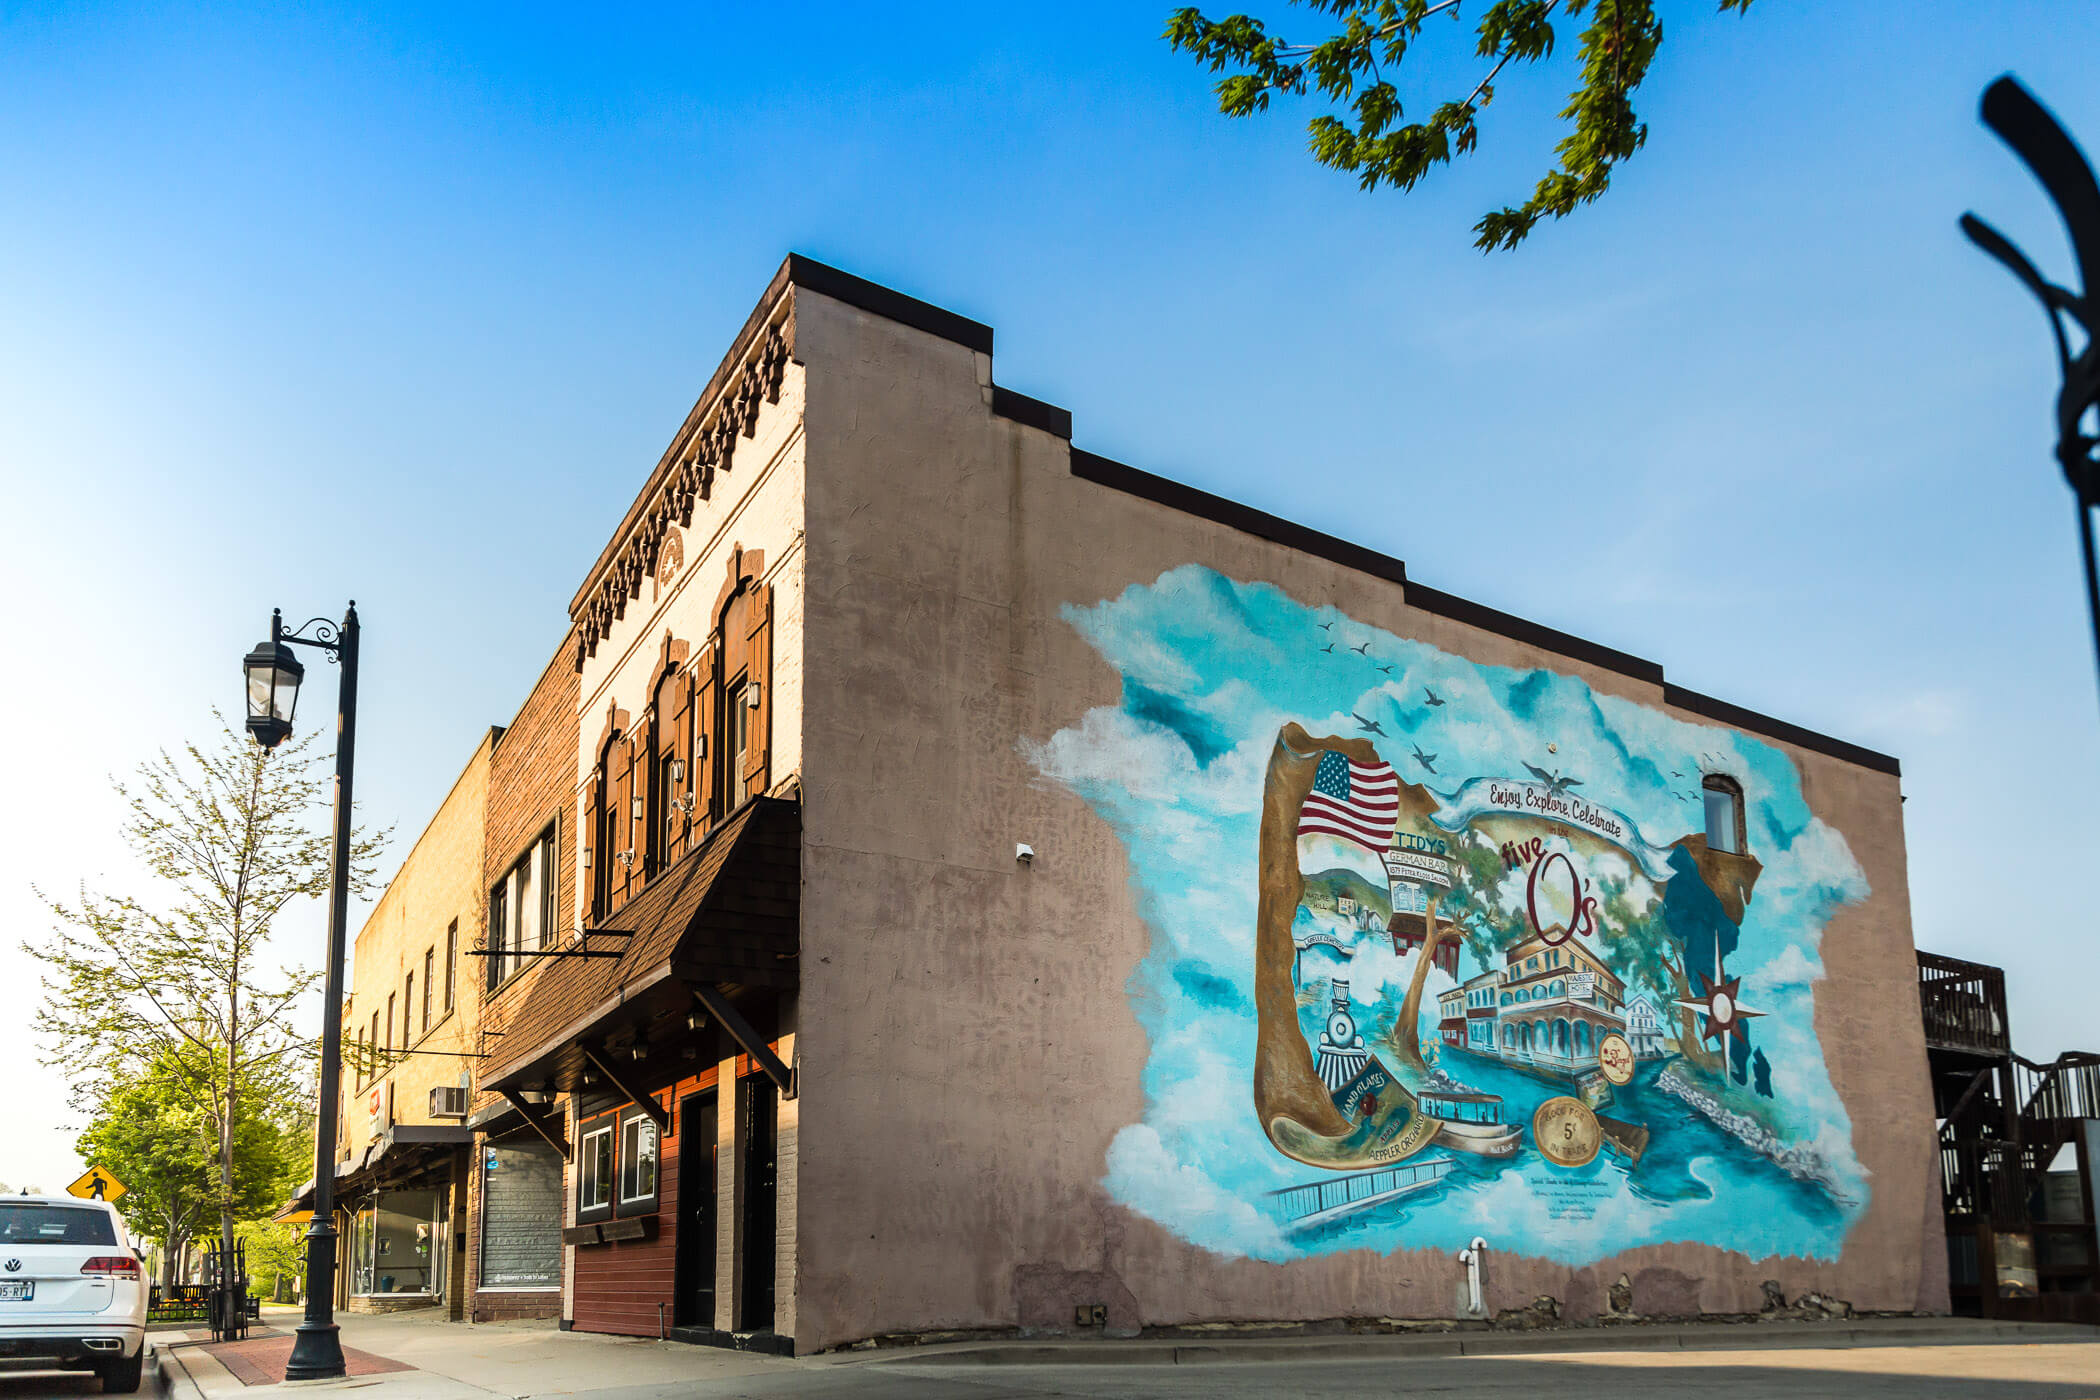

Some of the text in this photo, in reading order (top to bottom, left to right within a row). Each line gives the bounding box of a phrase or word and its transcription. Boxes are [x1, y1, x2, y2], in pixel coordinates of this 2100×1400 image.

[1490, 784, 1621, 838] Enjoy, Explore, Celebrate
[1395, 831, 1446, 855] TIDYS
[1502, 837, 1547, 871] five
[1390, 851, 1428, 867] GERMAN
[1343, 1091, 1359, 1118] LAND
[1400, 1112, 1426, 1151] ORCHARD
